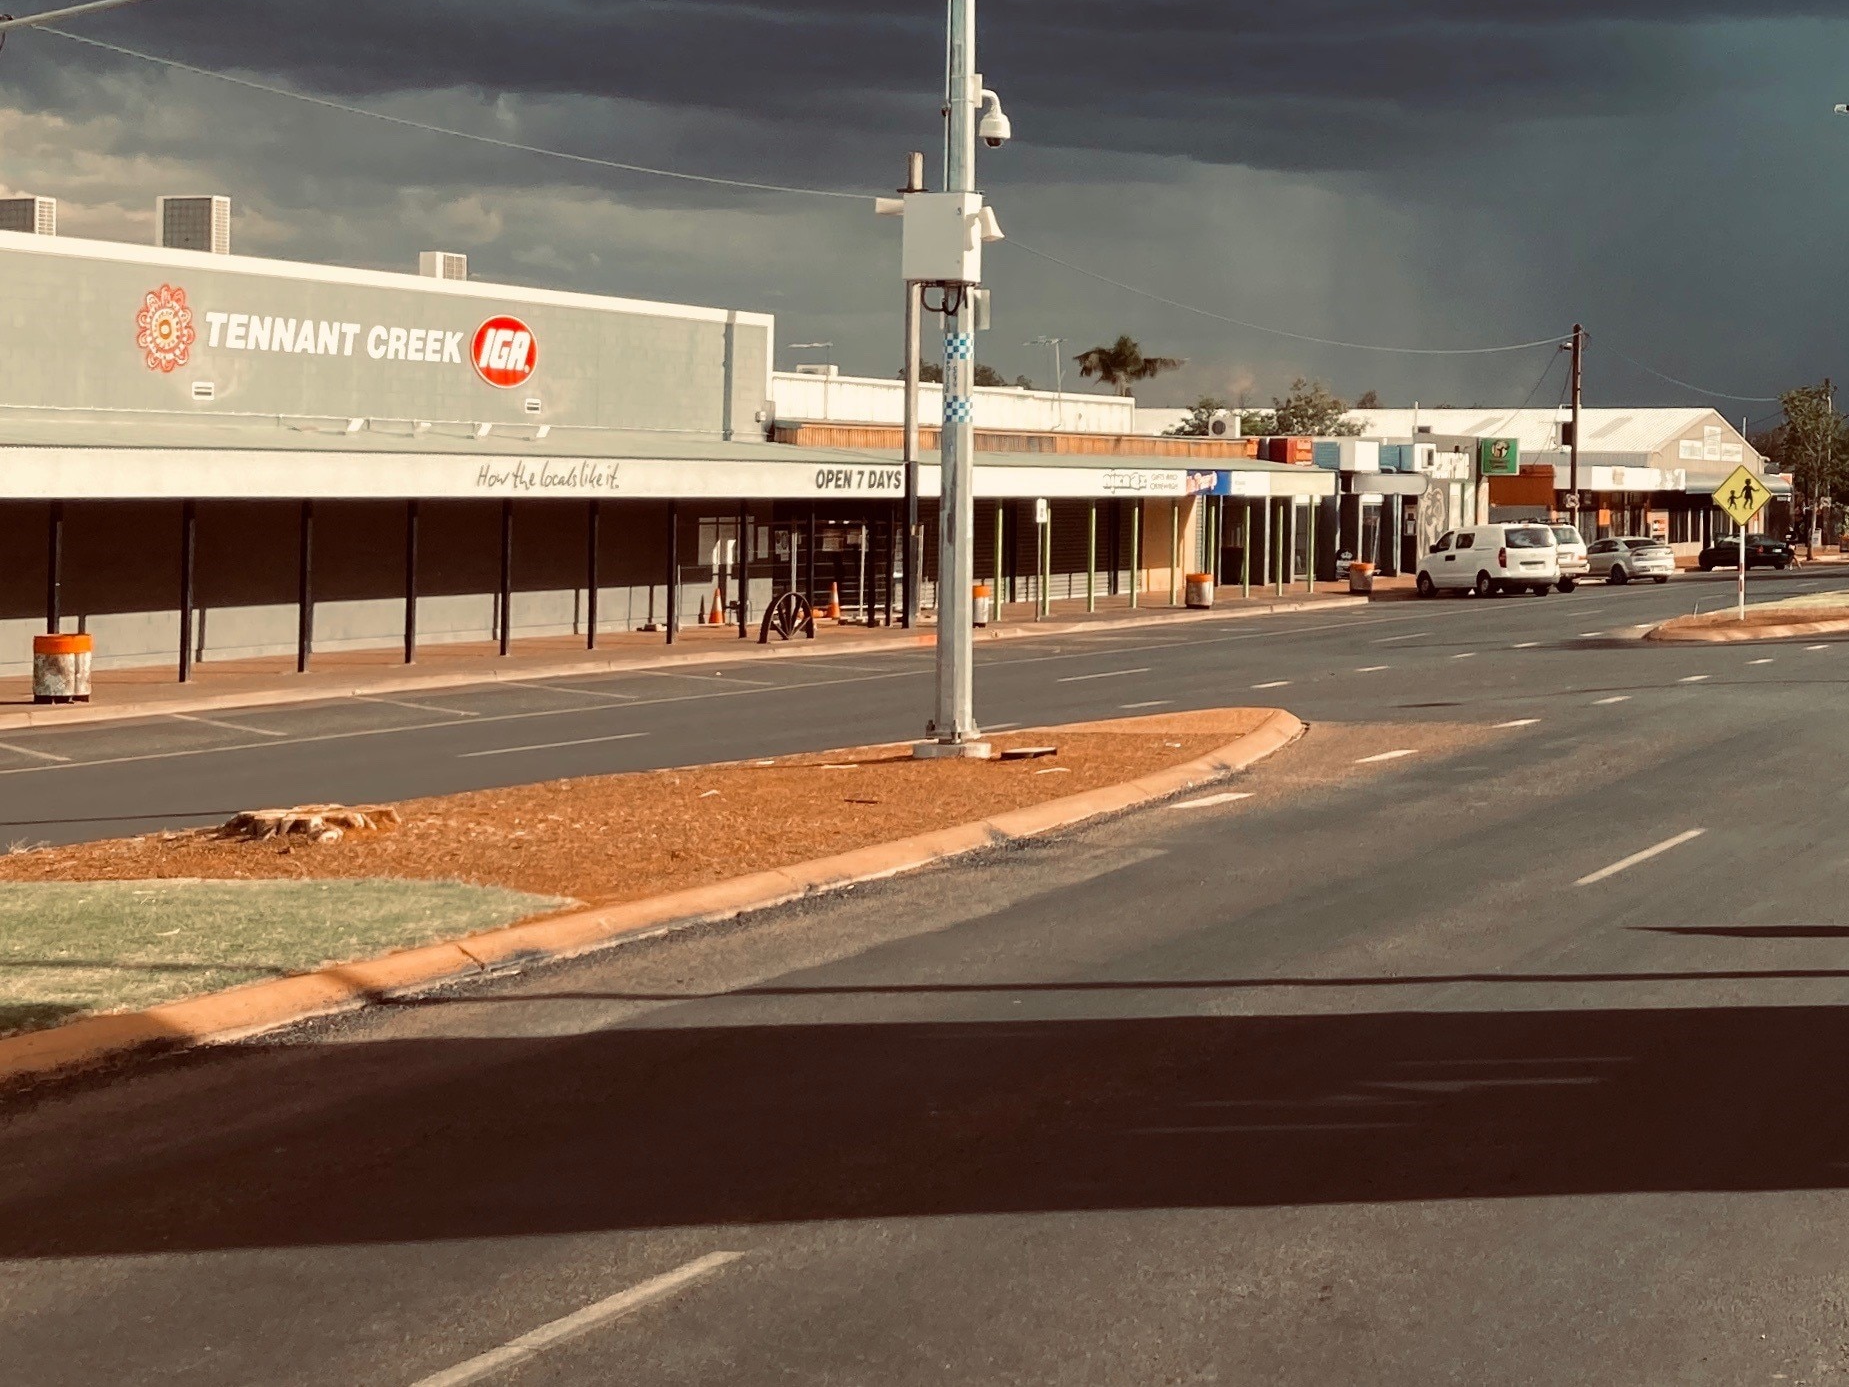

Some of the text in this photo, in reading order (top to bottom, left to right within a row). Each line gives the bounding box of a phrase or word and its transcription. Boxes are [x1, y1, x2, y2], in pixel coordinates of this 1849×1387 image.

[205, 312, 464, 363] TENNANT CREEK
[479, 328, 531, 372] IGA
[476, 464, 510, 487] How
[512, 460, 536, 490] the
[540, 460, 577, 488] locals
[579, 460, 602, 488] like
[815, 469, 902, 489] OPEN 7 DAYS
